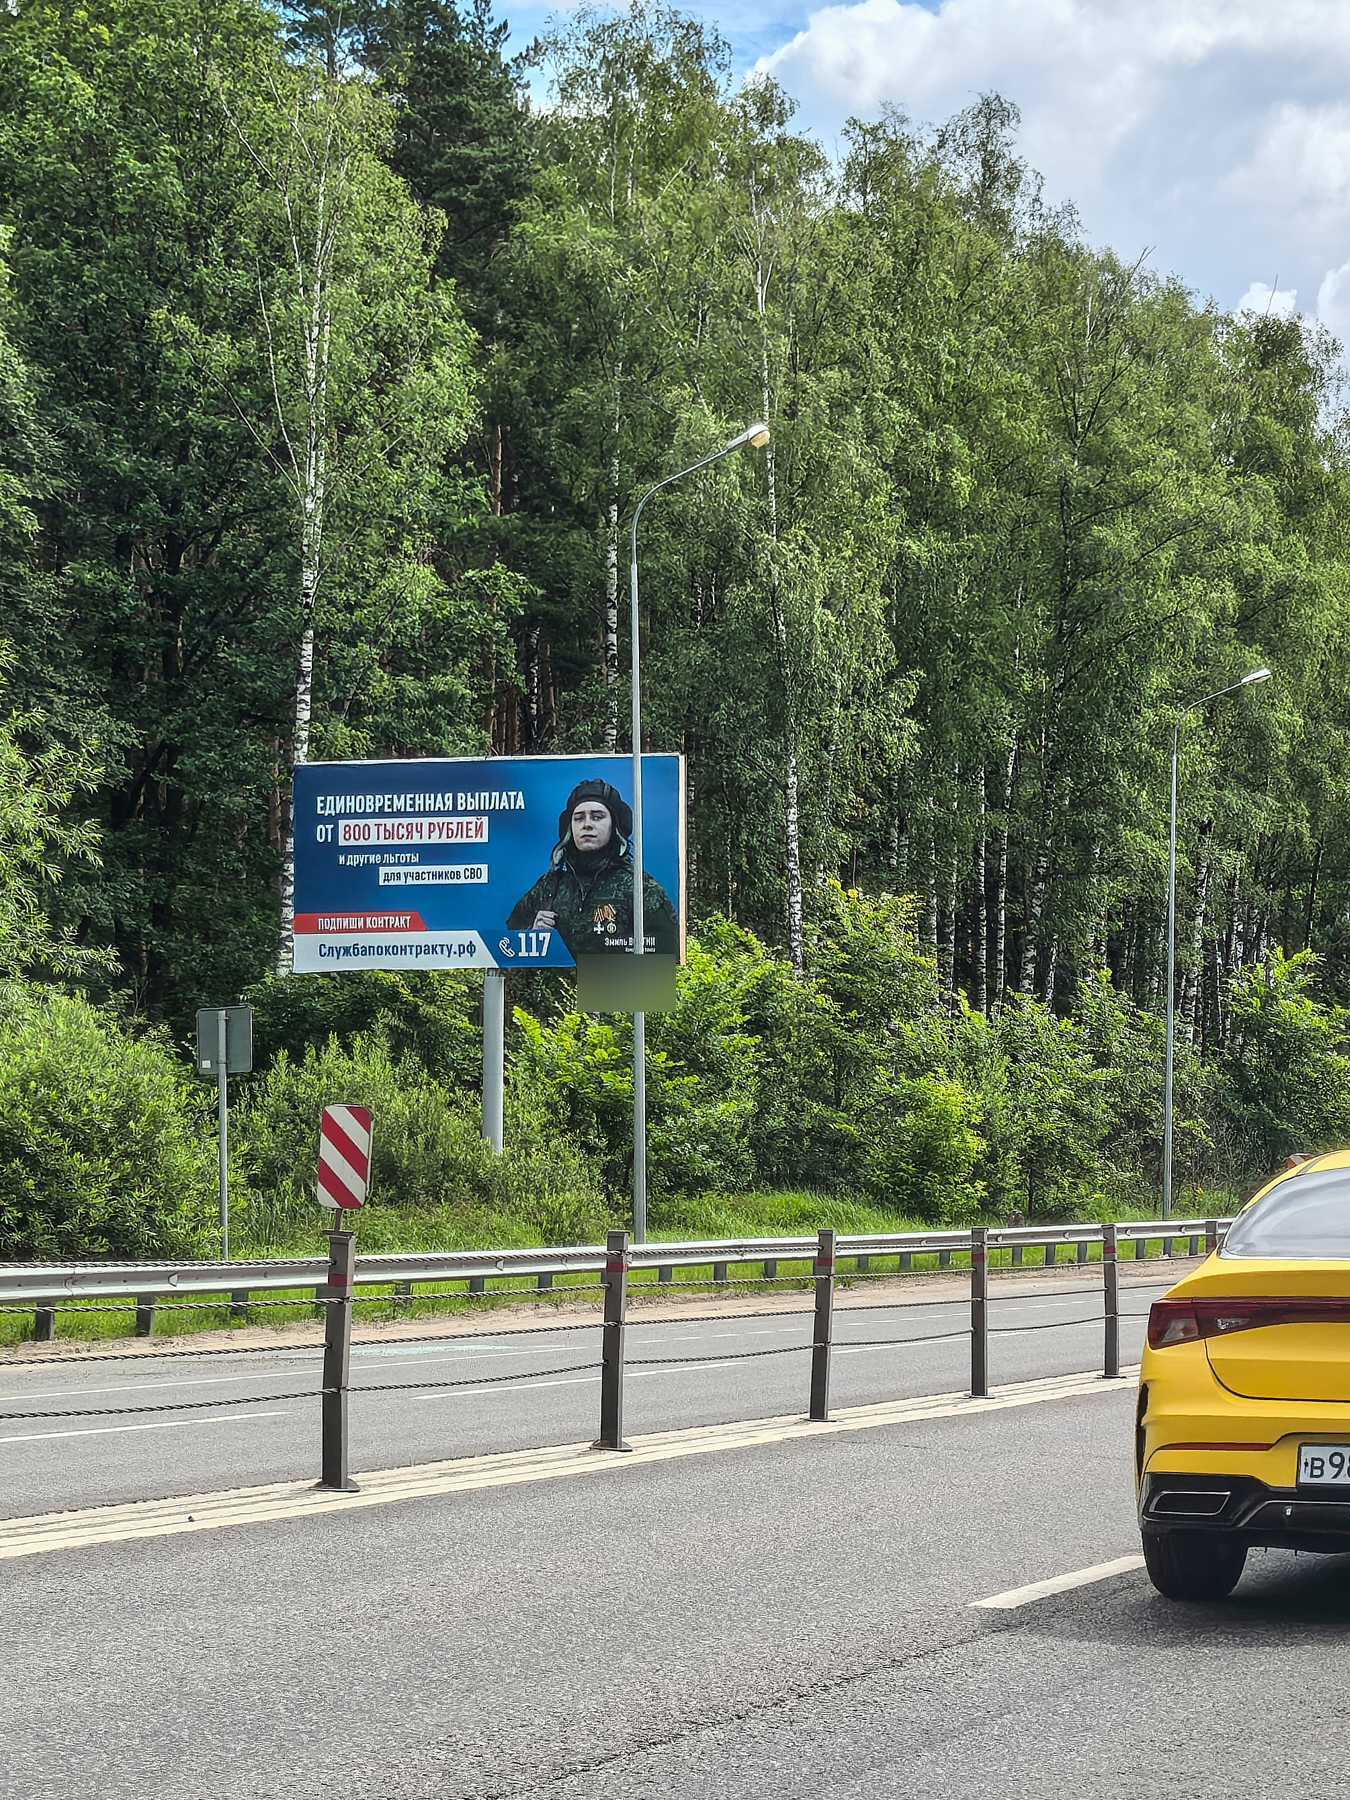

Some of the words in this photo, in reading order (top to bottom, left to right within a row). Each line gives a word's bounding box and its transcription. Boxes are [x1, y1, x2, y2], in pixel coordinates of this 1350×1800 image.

[316, 793, 453, 816] ЕДИНОВРЕМЕННАЯ
[457, 791, 525, 811] ВЫПЛАТА
[316, 824, 334, 843] ОТ
[343, 823, 371, 842] 800
[374, 822, 423, 841] ТЫСЯЧ
[428, 817, 483, 840] РУБЛЕЙ
[338, 855, 345, 865] и
[346, 853, 382, 867] другие
[382, 852, 419, 864] льготы
[383, 872, 401, 884] для
[403, 869, 461, 884] участников
[463, 868, 482, 880] СВО
[318, 917, 364, 931] ПОДПИШИ
[366, 915, 411, 929] КОНТРАКТ
[318, 941, 476, 960] Службапоконтракту.рф
[518, 932, 551, 957] 117
